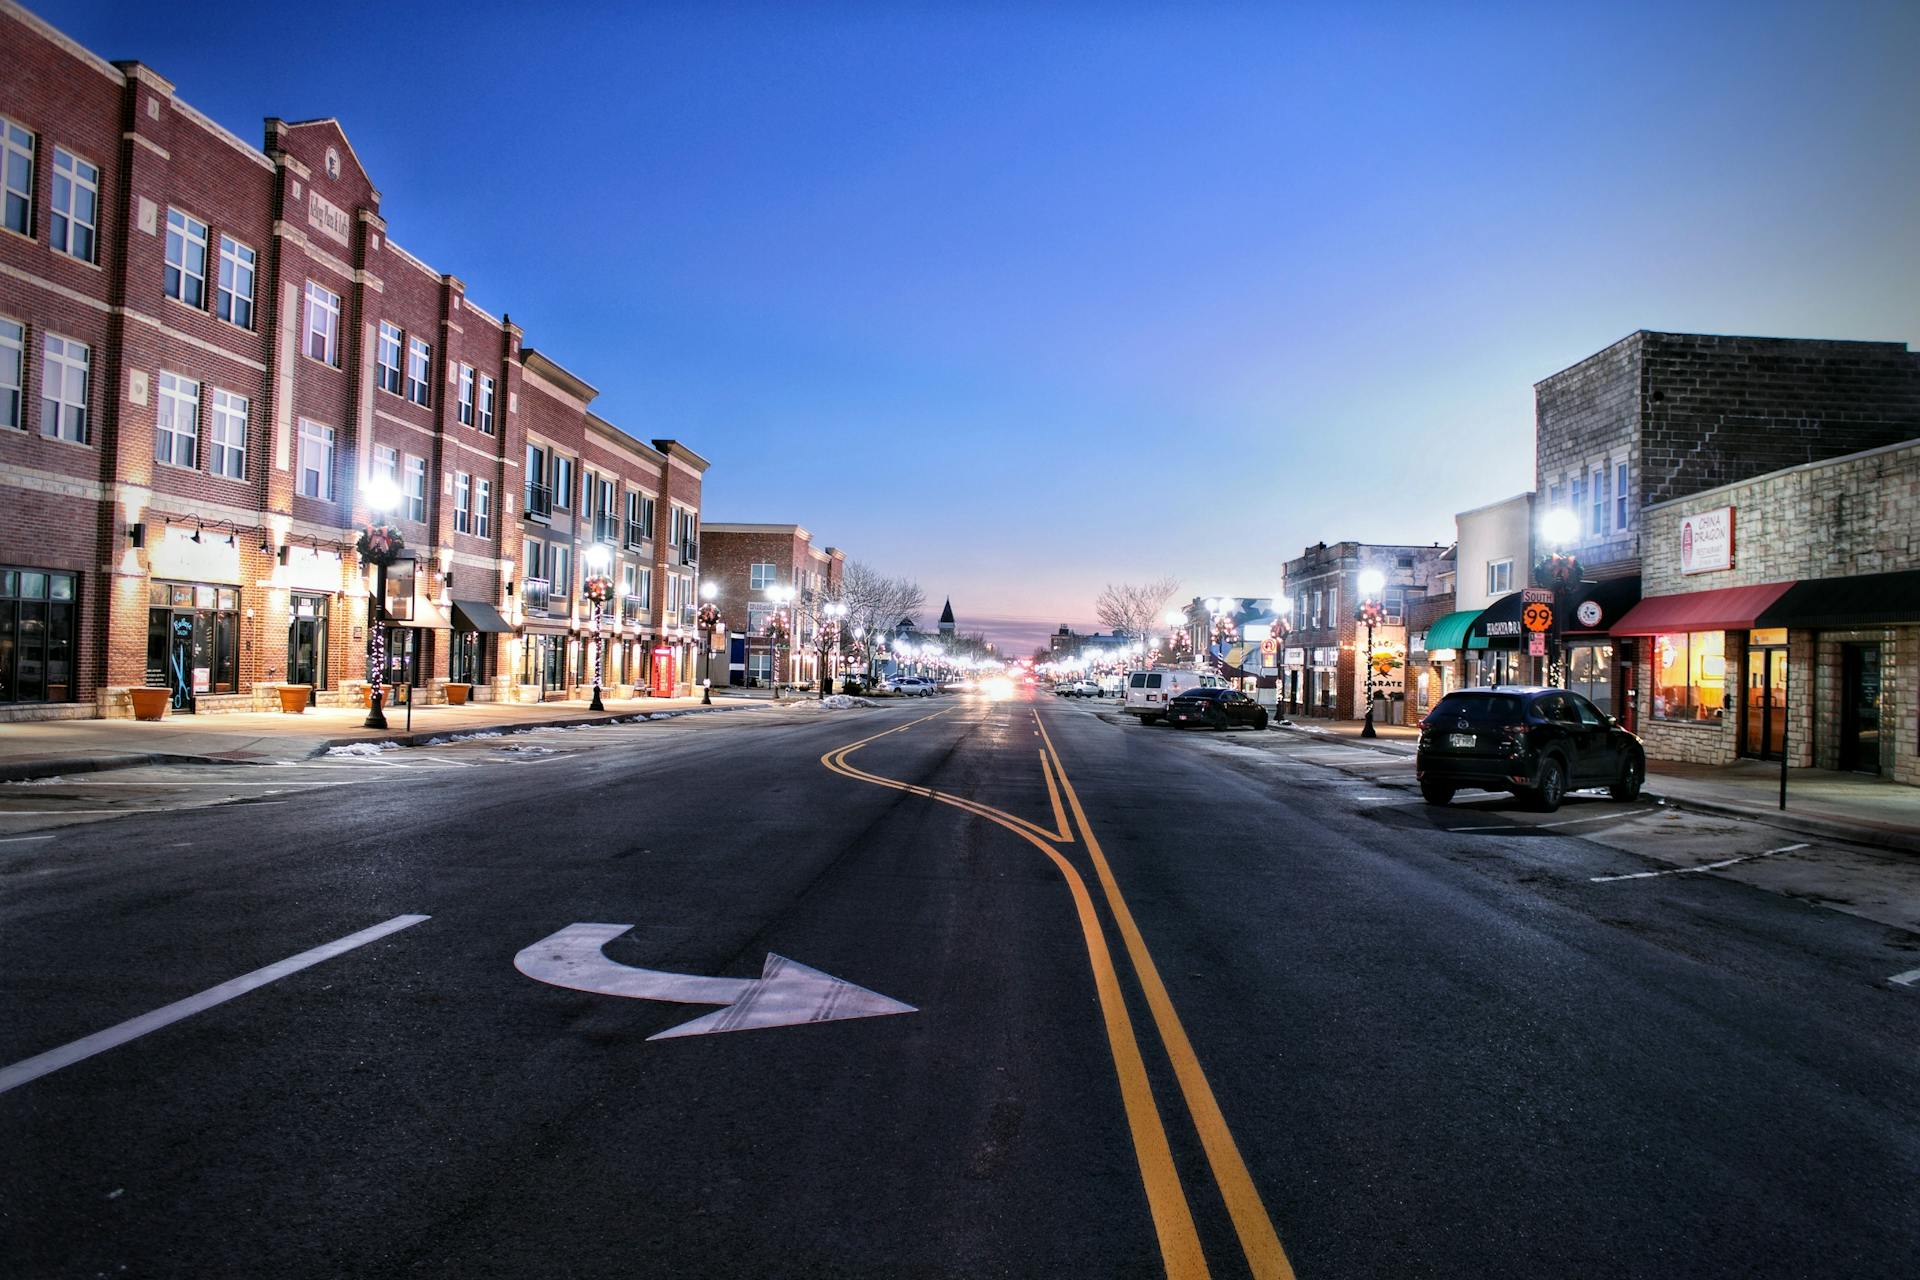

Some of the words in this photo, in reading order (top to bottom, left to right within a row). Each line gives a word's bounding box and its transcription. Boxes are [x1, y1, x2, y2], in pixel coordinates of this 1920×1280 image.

[1699, 514, 1721, 530] CHINA
[1695, 527, 1725, 542] DRAGON
[1525, 591, 1552, 602] SOUTH
[1527, 609, 1549, 625] 99
